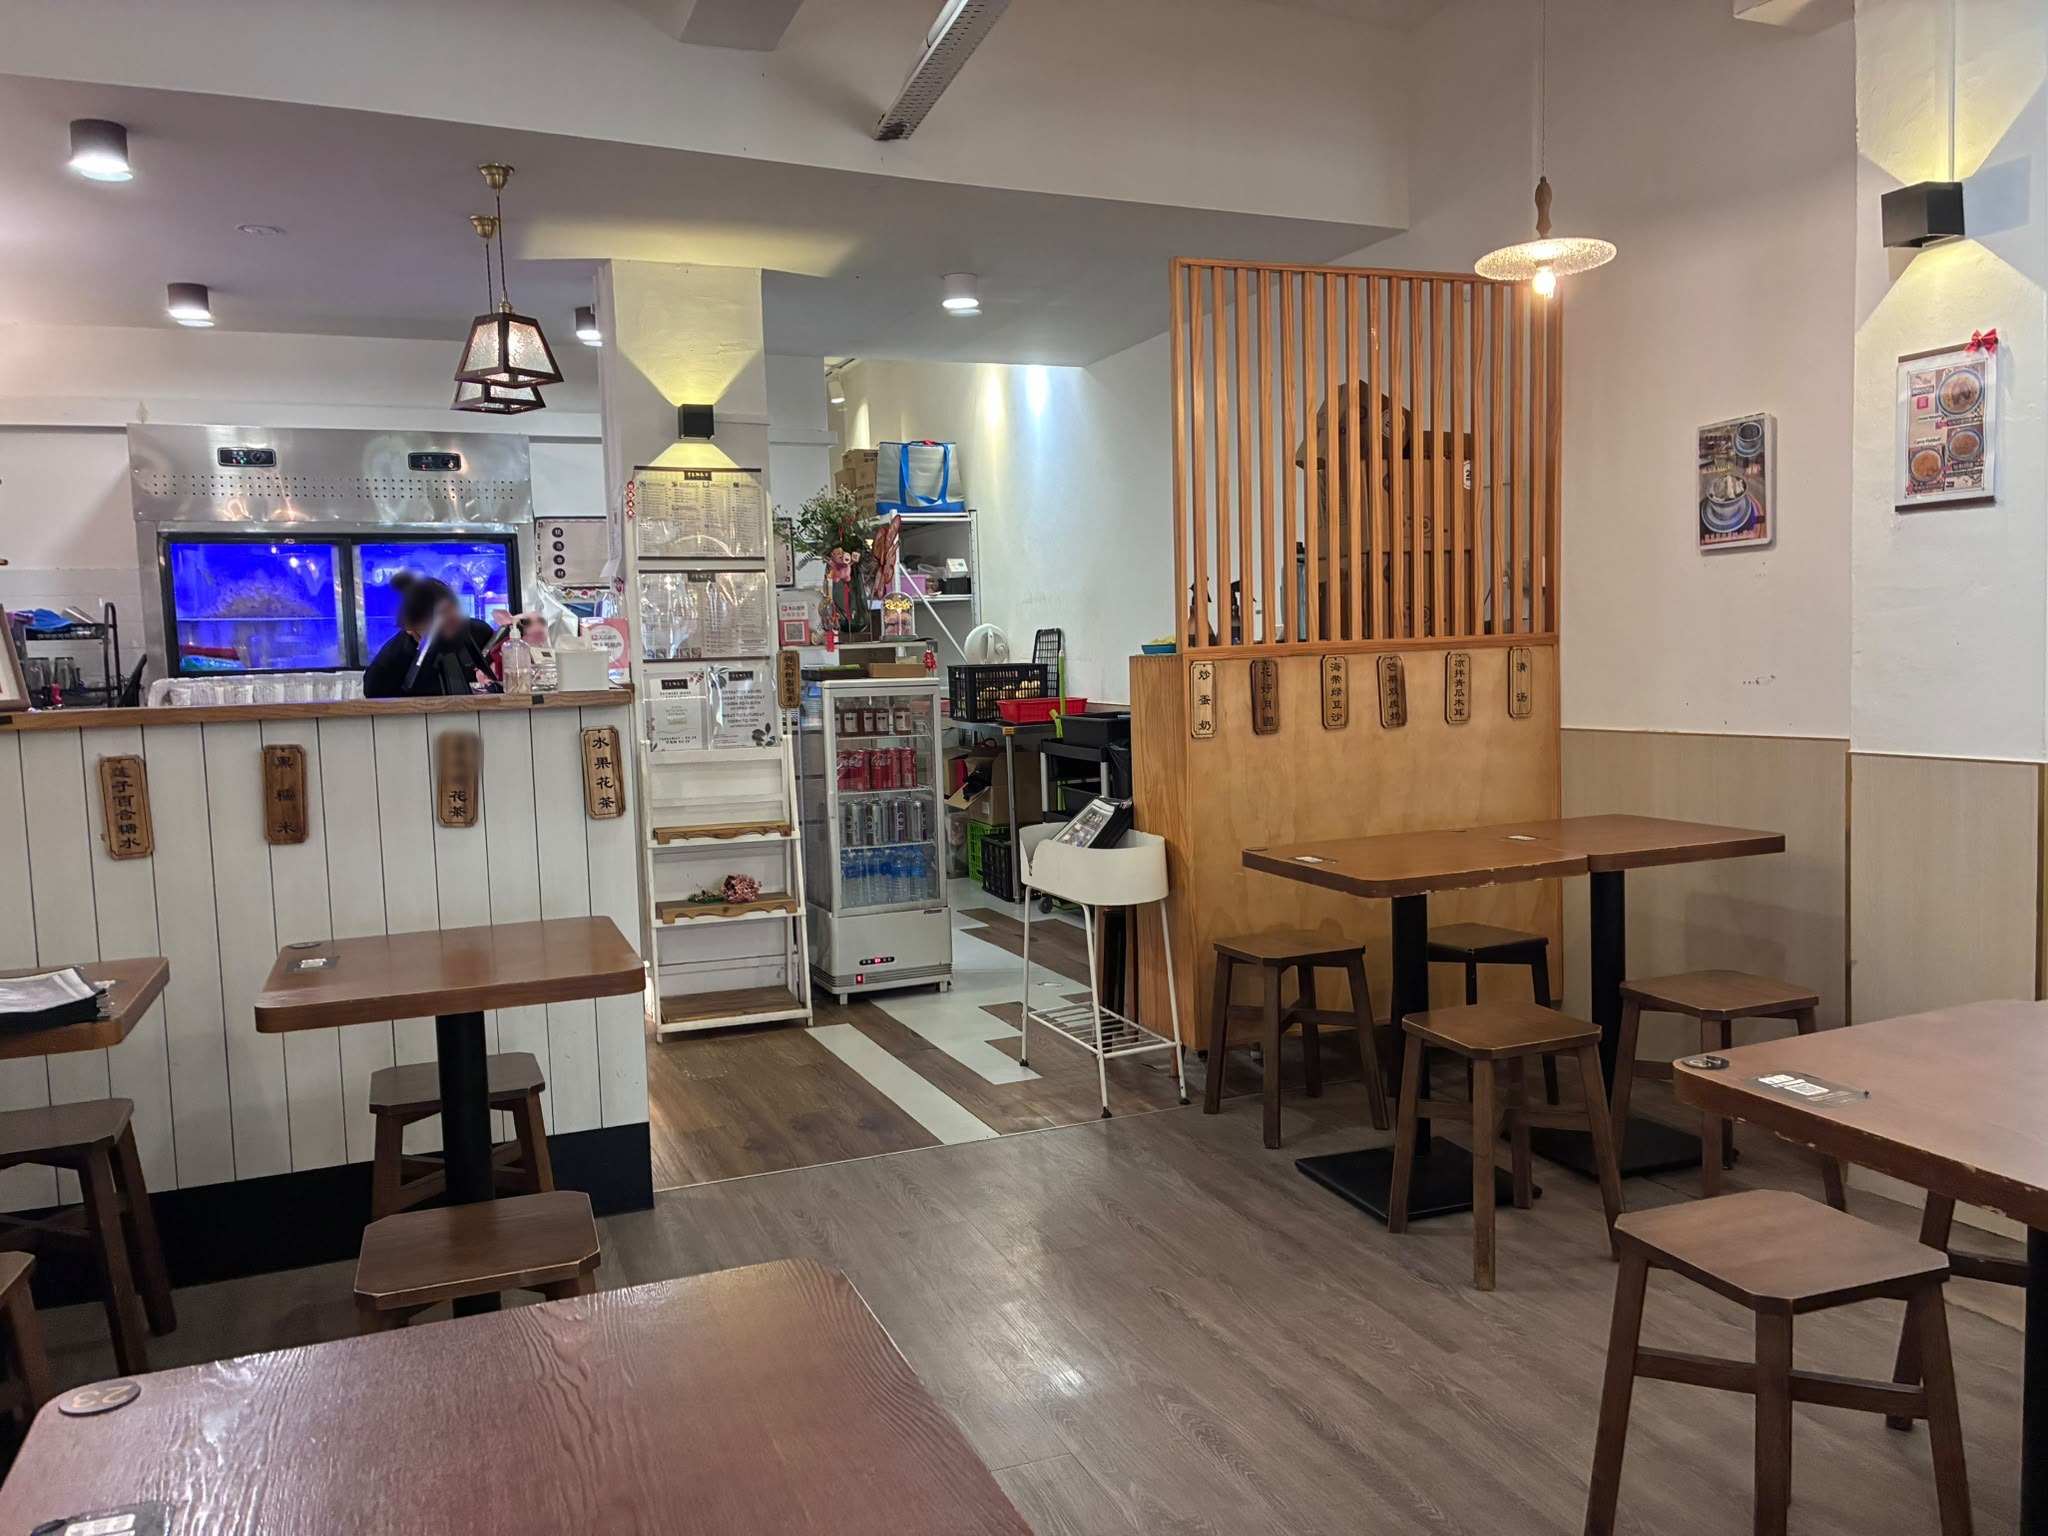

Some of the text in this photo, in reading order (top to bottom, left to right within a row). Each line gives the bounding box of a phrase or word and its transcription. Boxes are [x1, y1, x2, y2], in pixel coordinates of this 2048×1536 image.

[1453, 658, 1466, 717] 凉拌青瓜木耳
[1516, 661, 1528, 703] 清汤
[273, 756, 297, 834] 黑糯米
[592, 736, 616, 809] 水果花茶
[111, 766, 141, 850] 莲子百合糖水
[72, 1385, 131, 1409] 23
